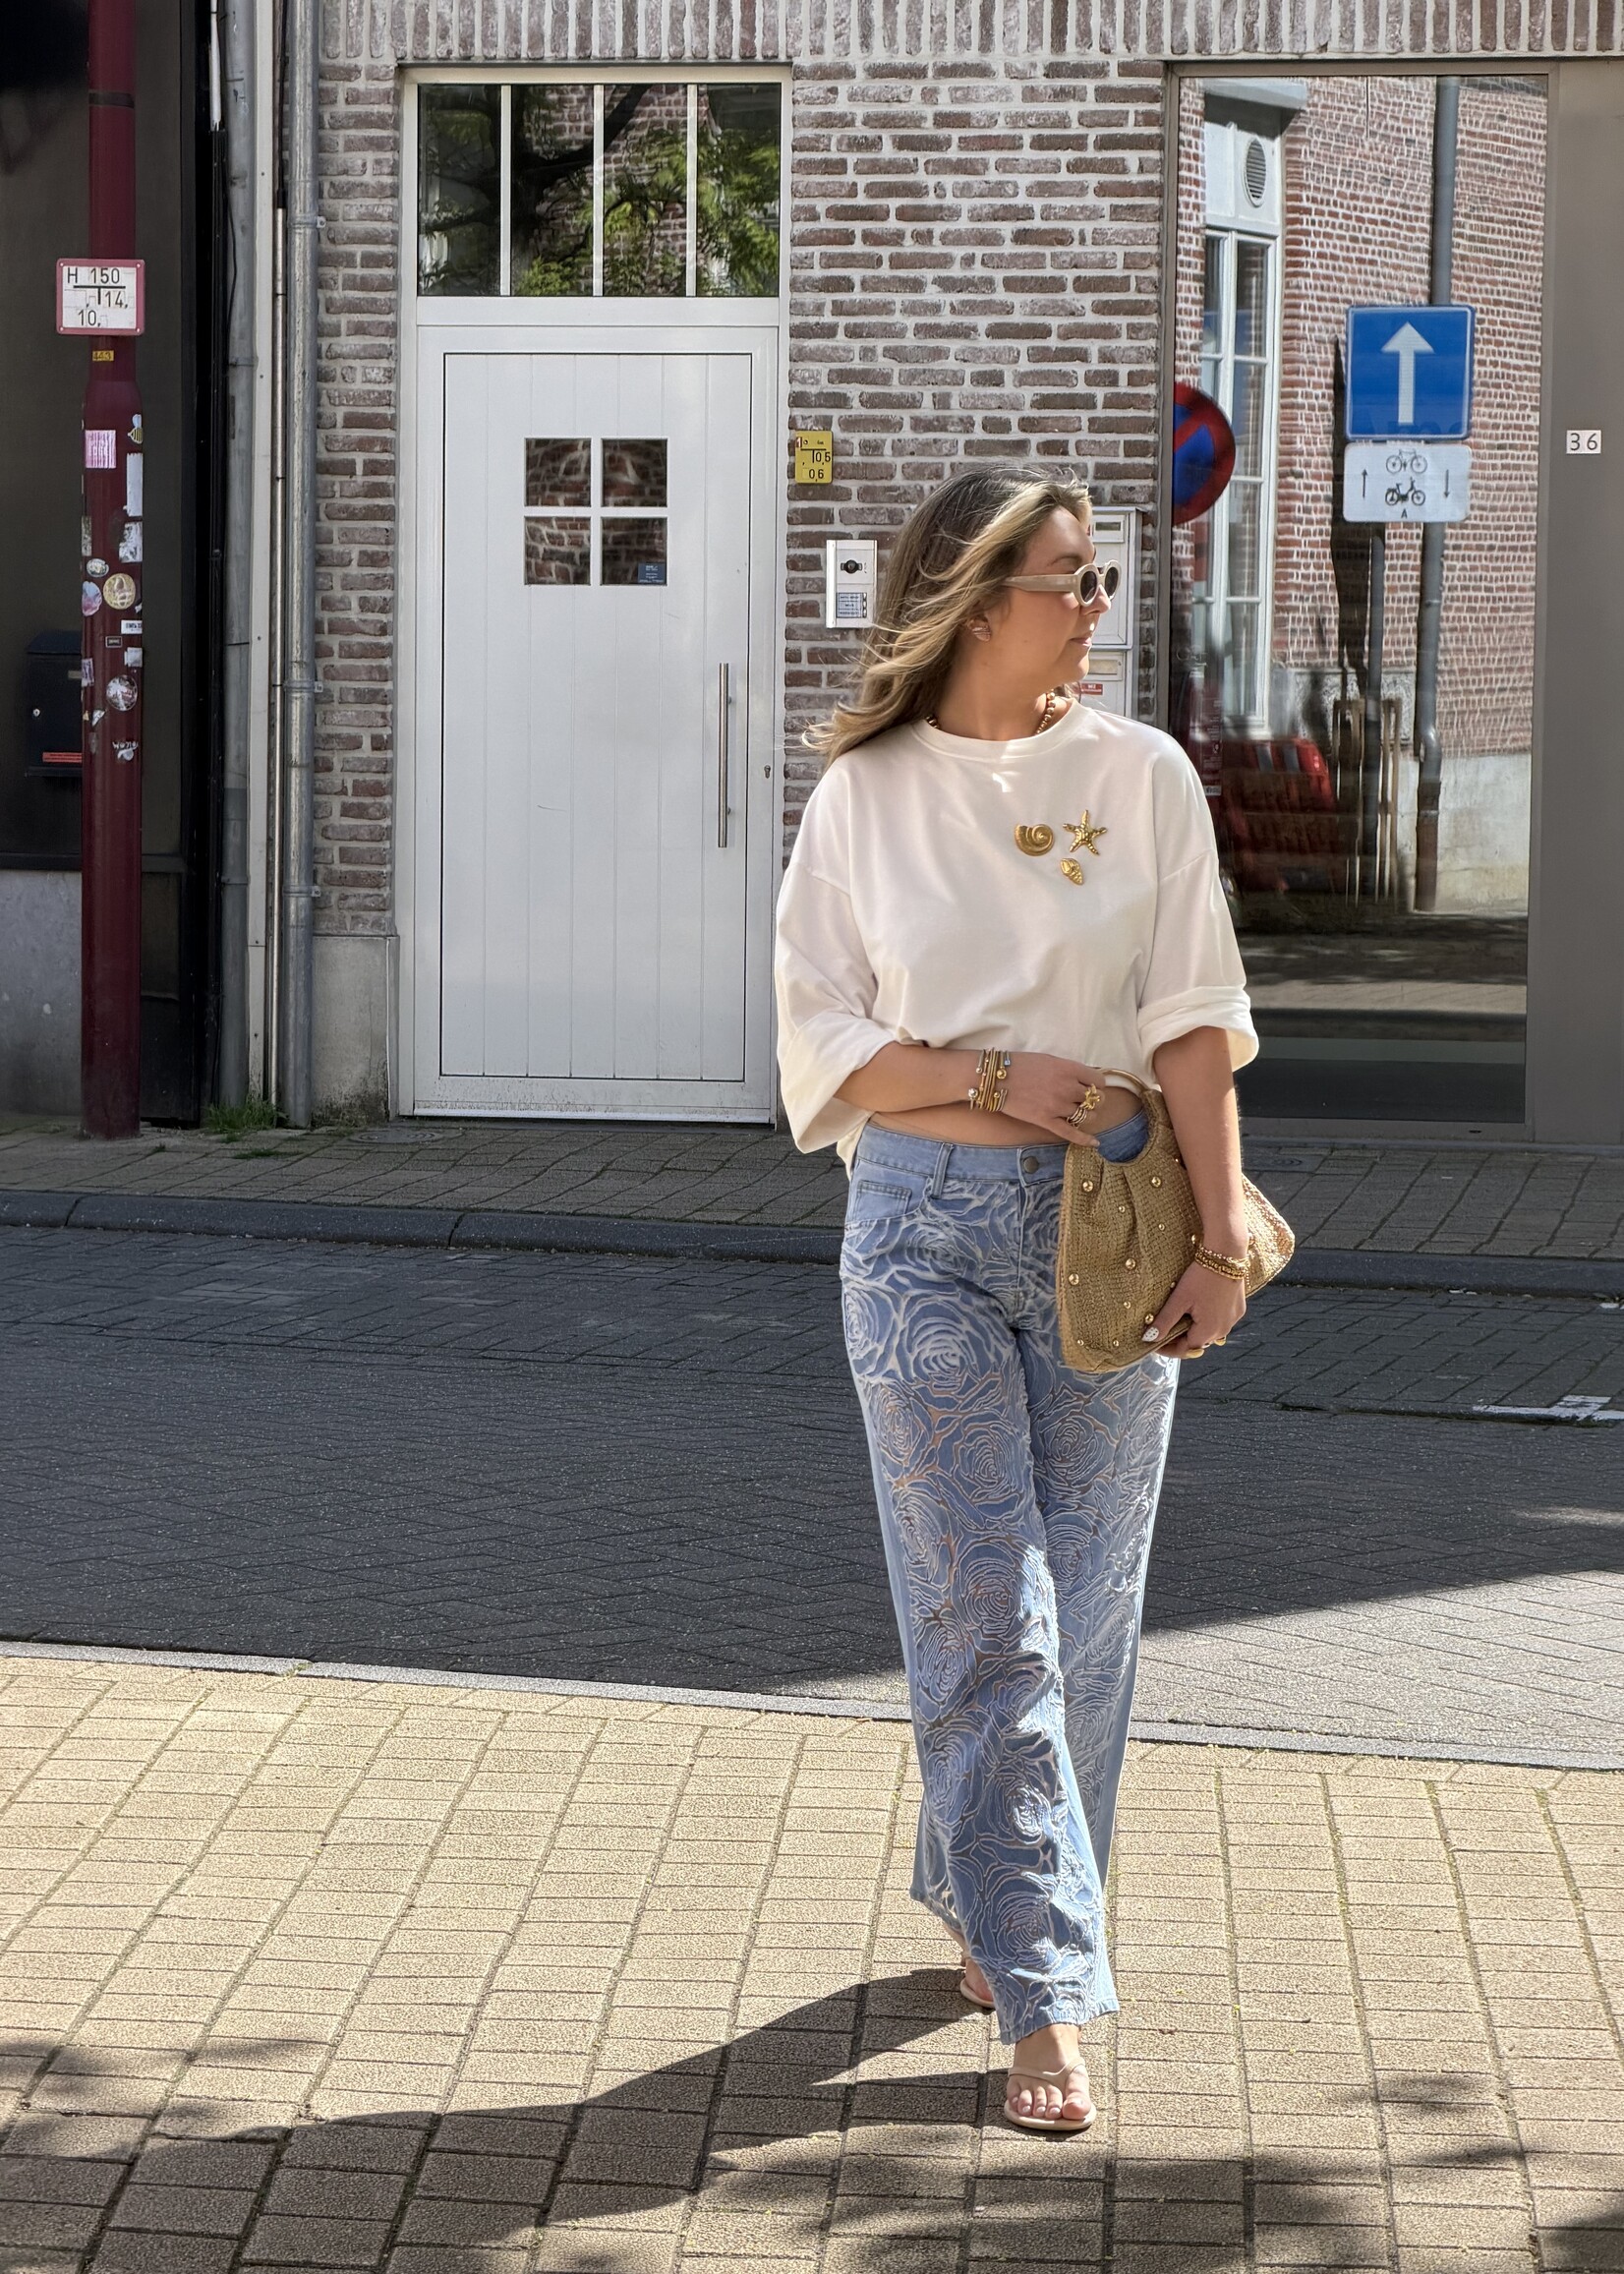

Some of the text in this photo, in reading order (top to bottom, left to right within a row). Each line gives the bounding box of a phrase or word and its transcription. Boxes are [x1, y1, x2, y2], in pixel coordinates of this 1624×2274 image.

[67, 267, 120, 284] H 150
[1570, 433, 1597, 451] 36
